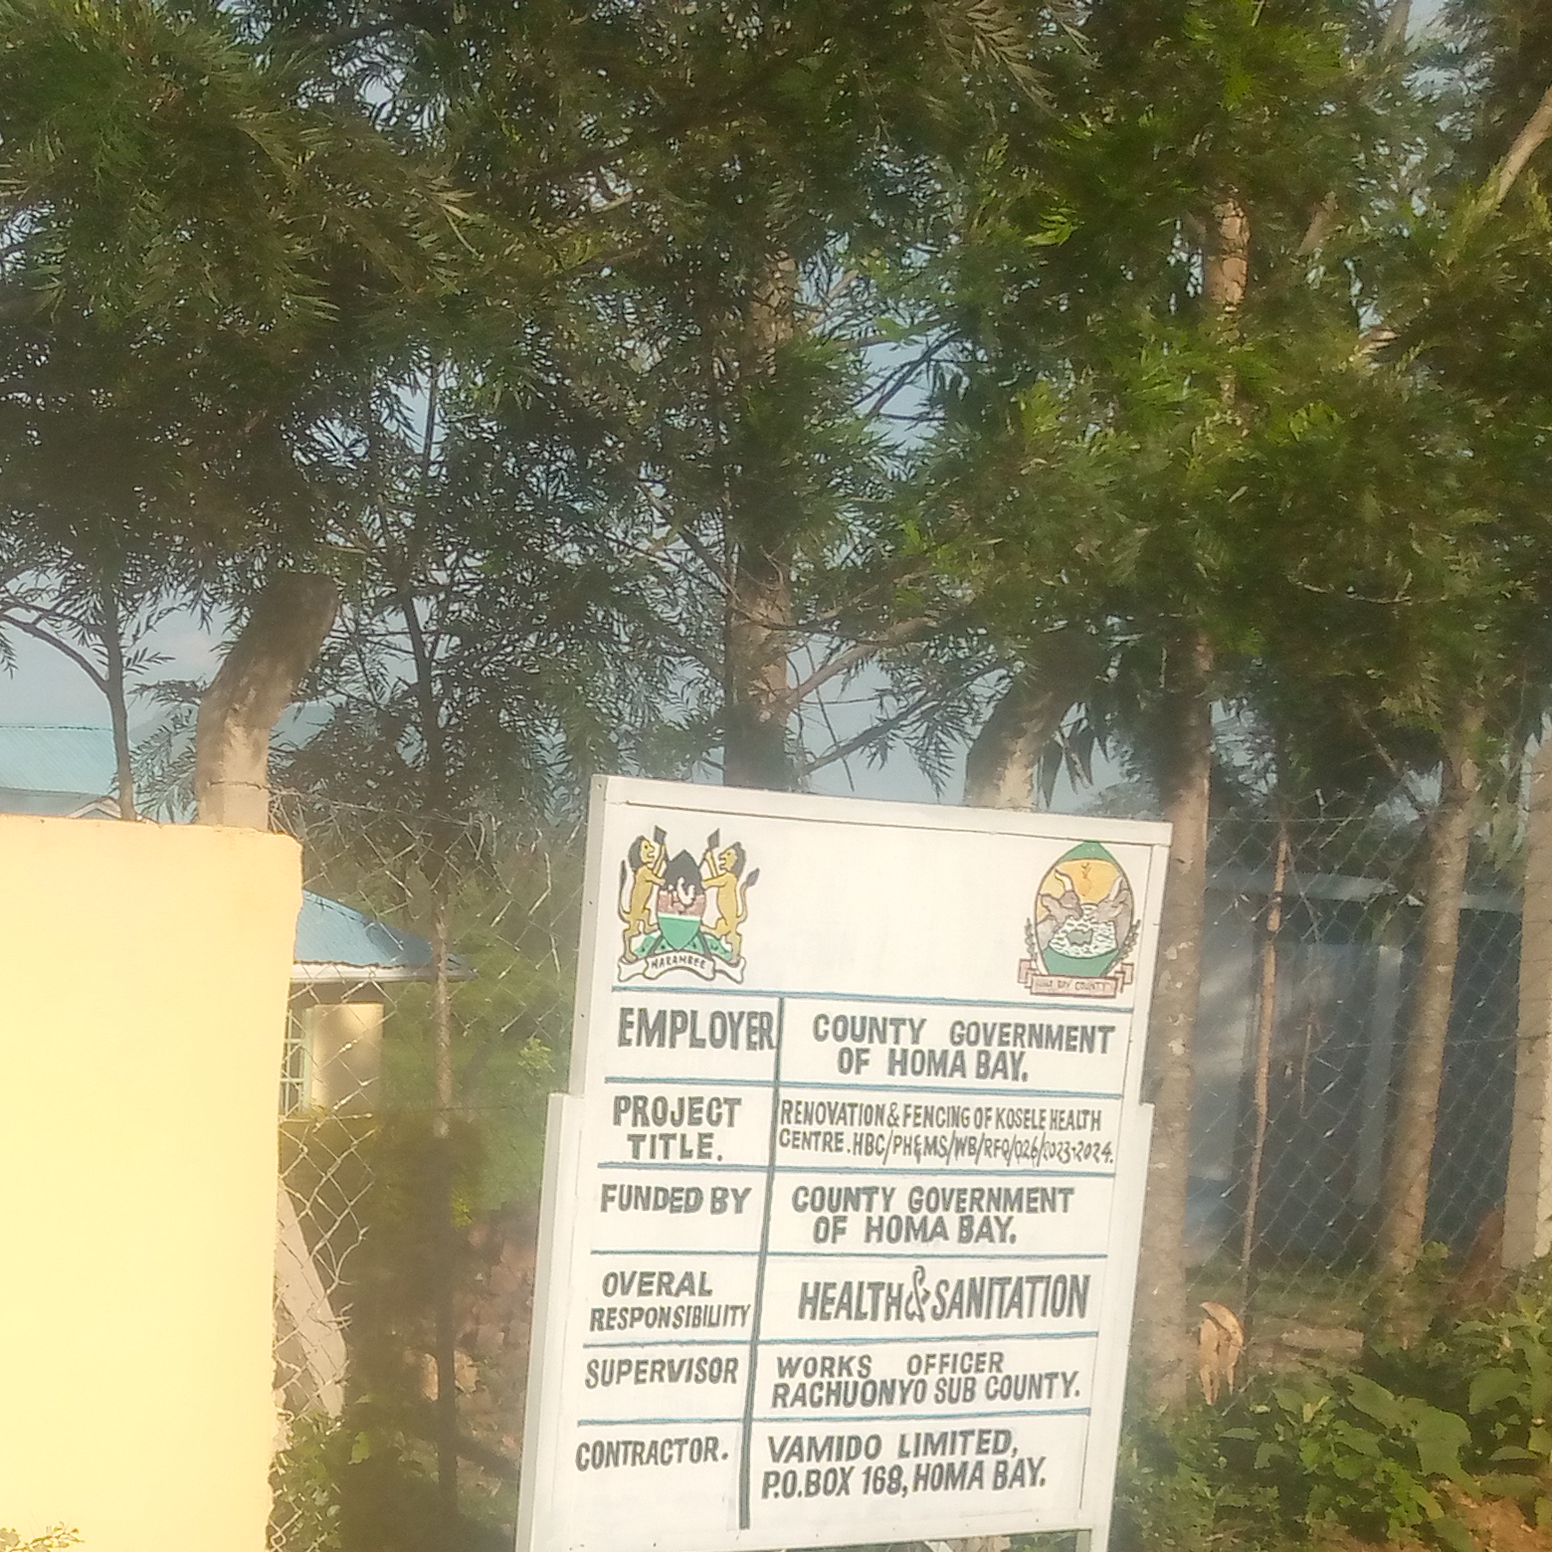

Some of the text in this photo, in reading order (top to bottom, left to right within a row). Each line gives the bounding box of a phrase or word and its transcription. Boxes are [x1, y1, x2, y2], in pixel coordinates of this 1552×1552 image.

[618, 1007, 777, 1051] EMPLOYER
[813, 1013, 1116, 1055] COUNTY GOVERNMENT
[837, 1046, 1029, 1083] OF HOMA BAY.
[613, 1095, 742, 1127] PROJECT
[974, 1107, 992, 1129] OF
[995, 1107, 1046, 1130] KOSELE
[1049, 1109, 1101, 1131] HEALTH
[627, 1132, 723, 1162] TITLE.
[601, 1183, 752, 1215] FUNDED BY
[792, 1186, 1075, 1214] COUNTY GOVERNMENT
[813, 1215, 1016, 1244] OF HOMA BAY.
[602, 1271, 713, 1298] OVERAL
[589, 1303, 751, 1333] RESPONSIBILITY
[584, 1357, 739, 1389] SUPERVISOR
[777, 1351, 1005, 1379] WORKS OFFICER
[770, 1371, 1081, 1409] RACHUONYO SUB COUNTY.
[575, 1436, 729, 1472] CONTRACTOR.
[768, 1429, 1018, 1464] VAMIDO LIMITED,
[913, 1460, 986, 1492] HOMA
[992, 1455, 1046, 1491] BAY.
